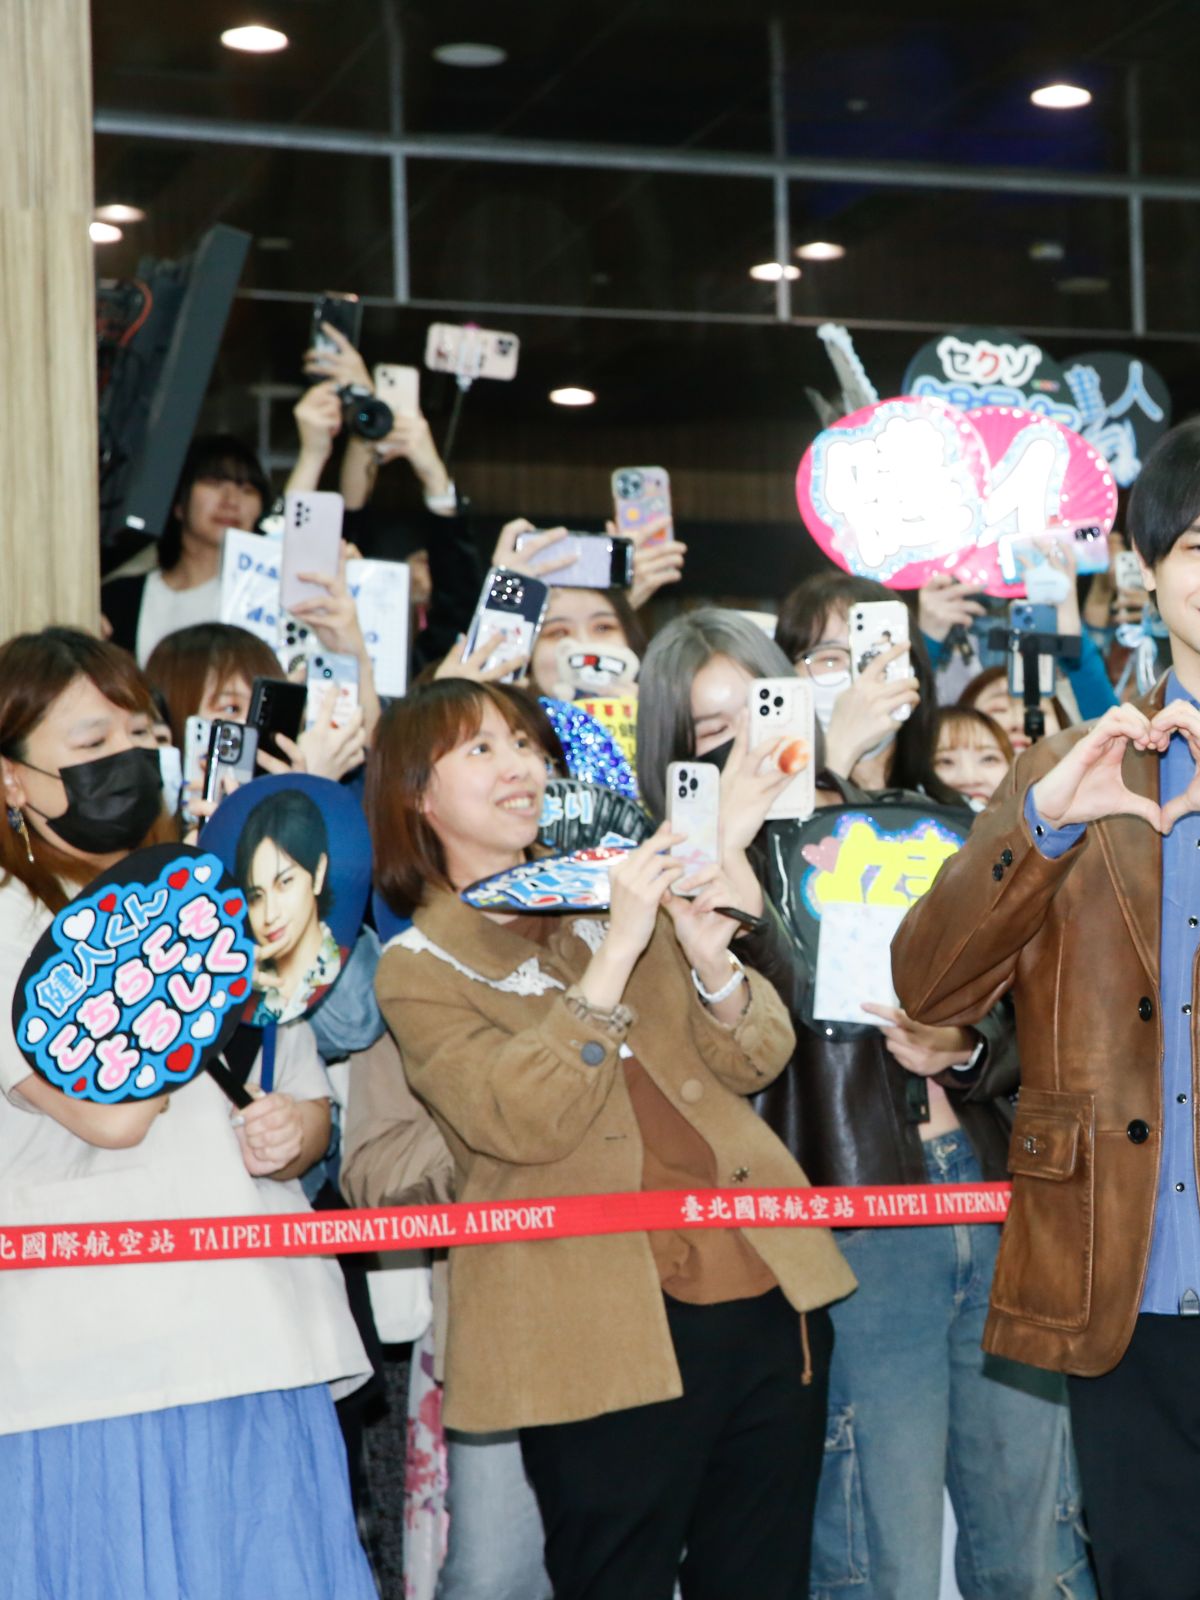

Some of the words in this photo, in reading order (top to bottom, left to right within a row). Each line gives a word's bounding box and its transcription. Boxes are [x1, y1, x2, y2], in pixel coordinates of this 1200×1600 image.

[49, 896, 220, 1073] こちらこそ
[96, 926, 248, 1091] よろしく
[680, 1194, 854, 1222] 臺北國際航空站
[864, 1192, 928, 1217] TAIPEI
[190, 1223, 271, 1252] TAIPEI
[282, 1213, 456, 1247] INTERNATIONAL
[465, 1205, 556, 1235] AIRPORT
